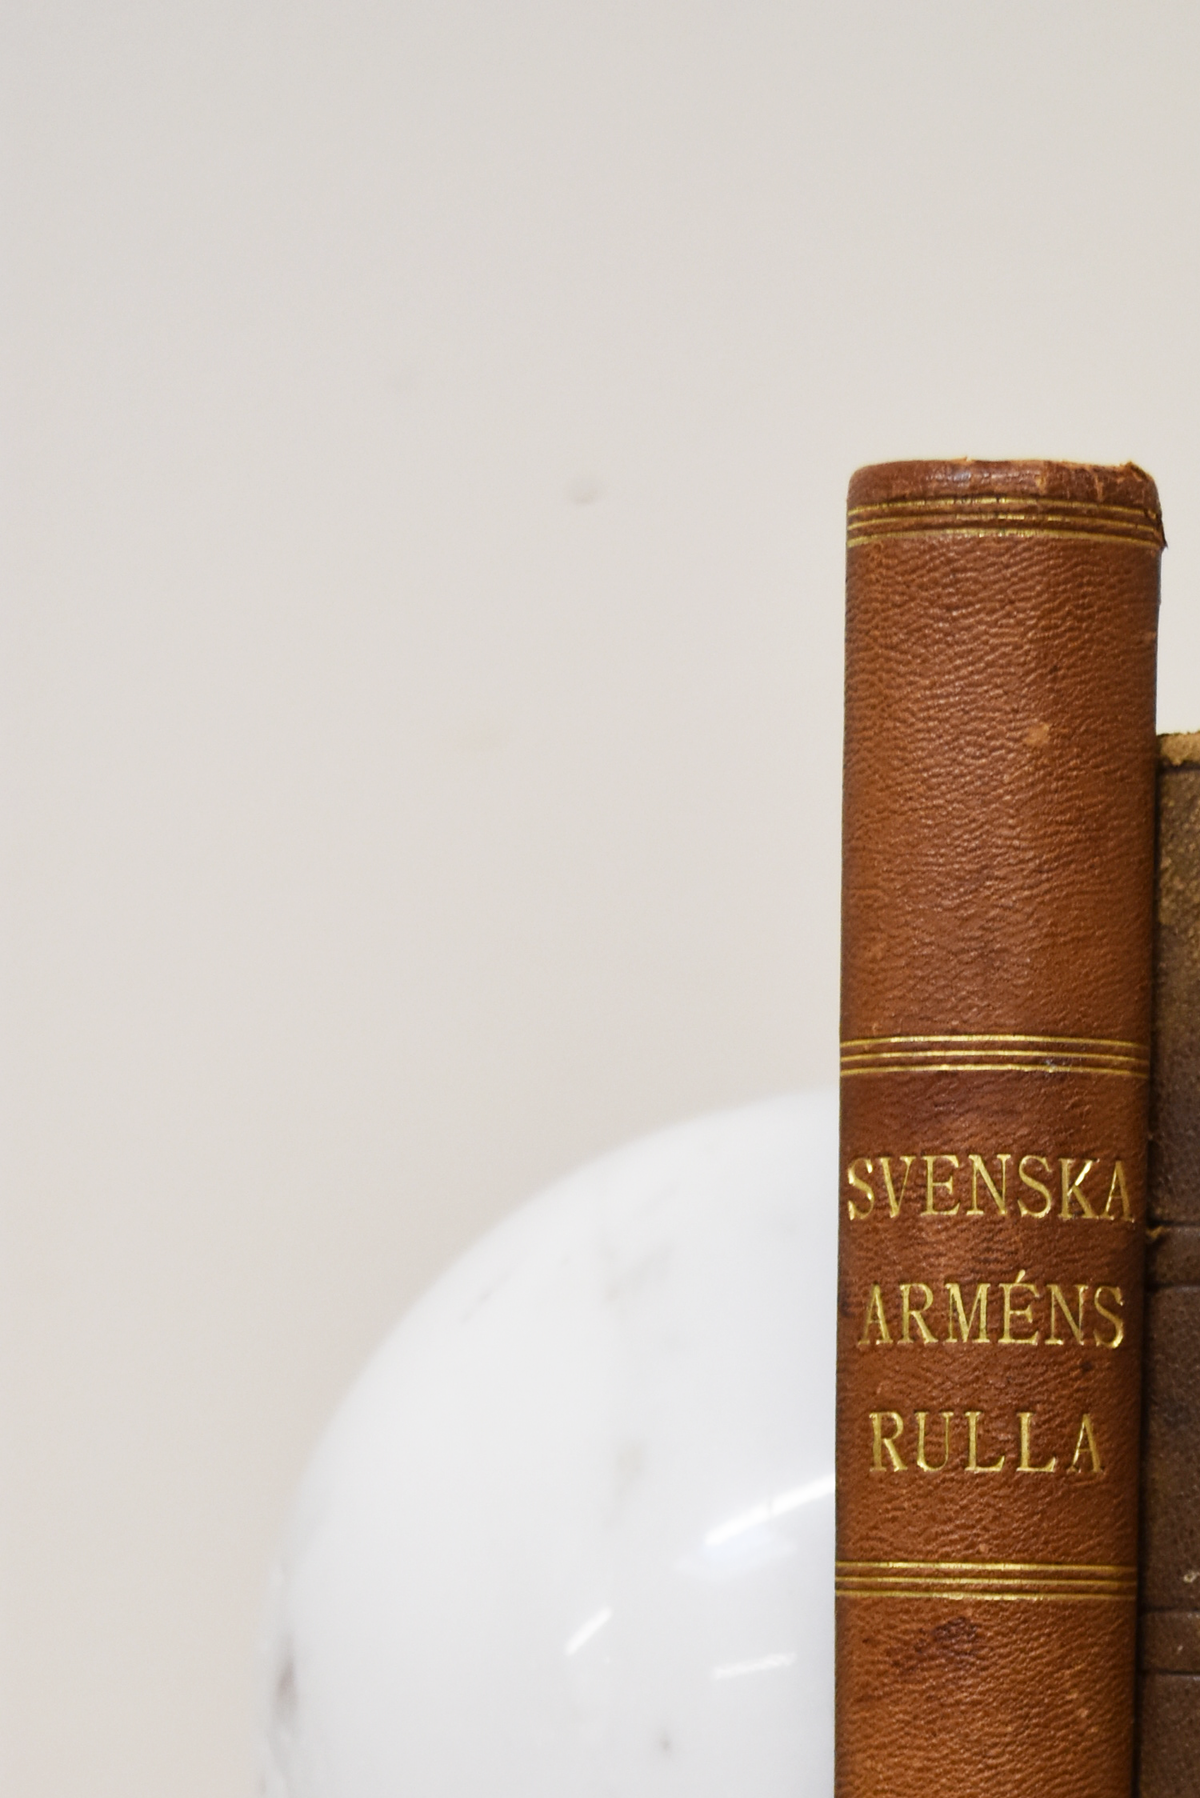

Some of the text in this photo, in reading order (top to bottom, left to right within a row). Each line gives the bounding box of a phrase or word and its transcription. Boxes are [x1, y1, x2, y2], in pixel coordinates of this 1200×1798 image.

[847, 1153, 1135, 1223] SVENSKA
[857, 1269, 1125, 1350] ARMÉNS
[868, 1411, 1104, 1474] RULLA
